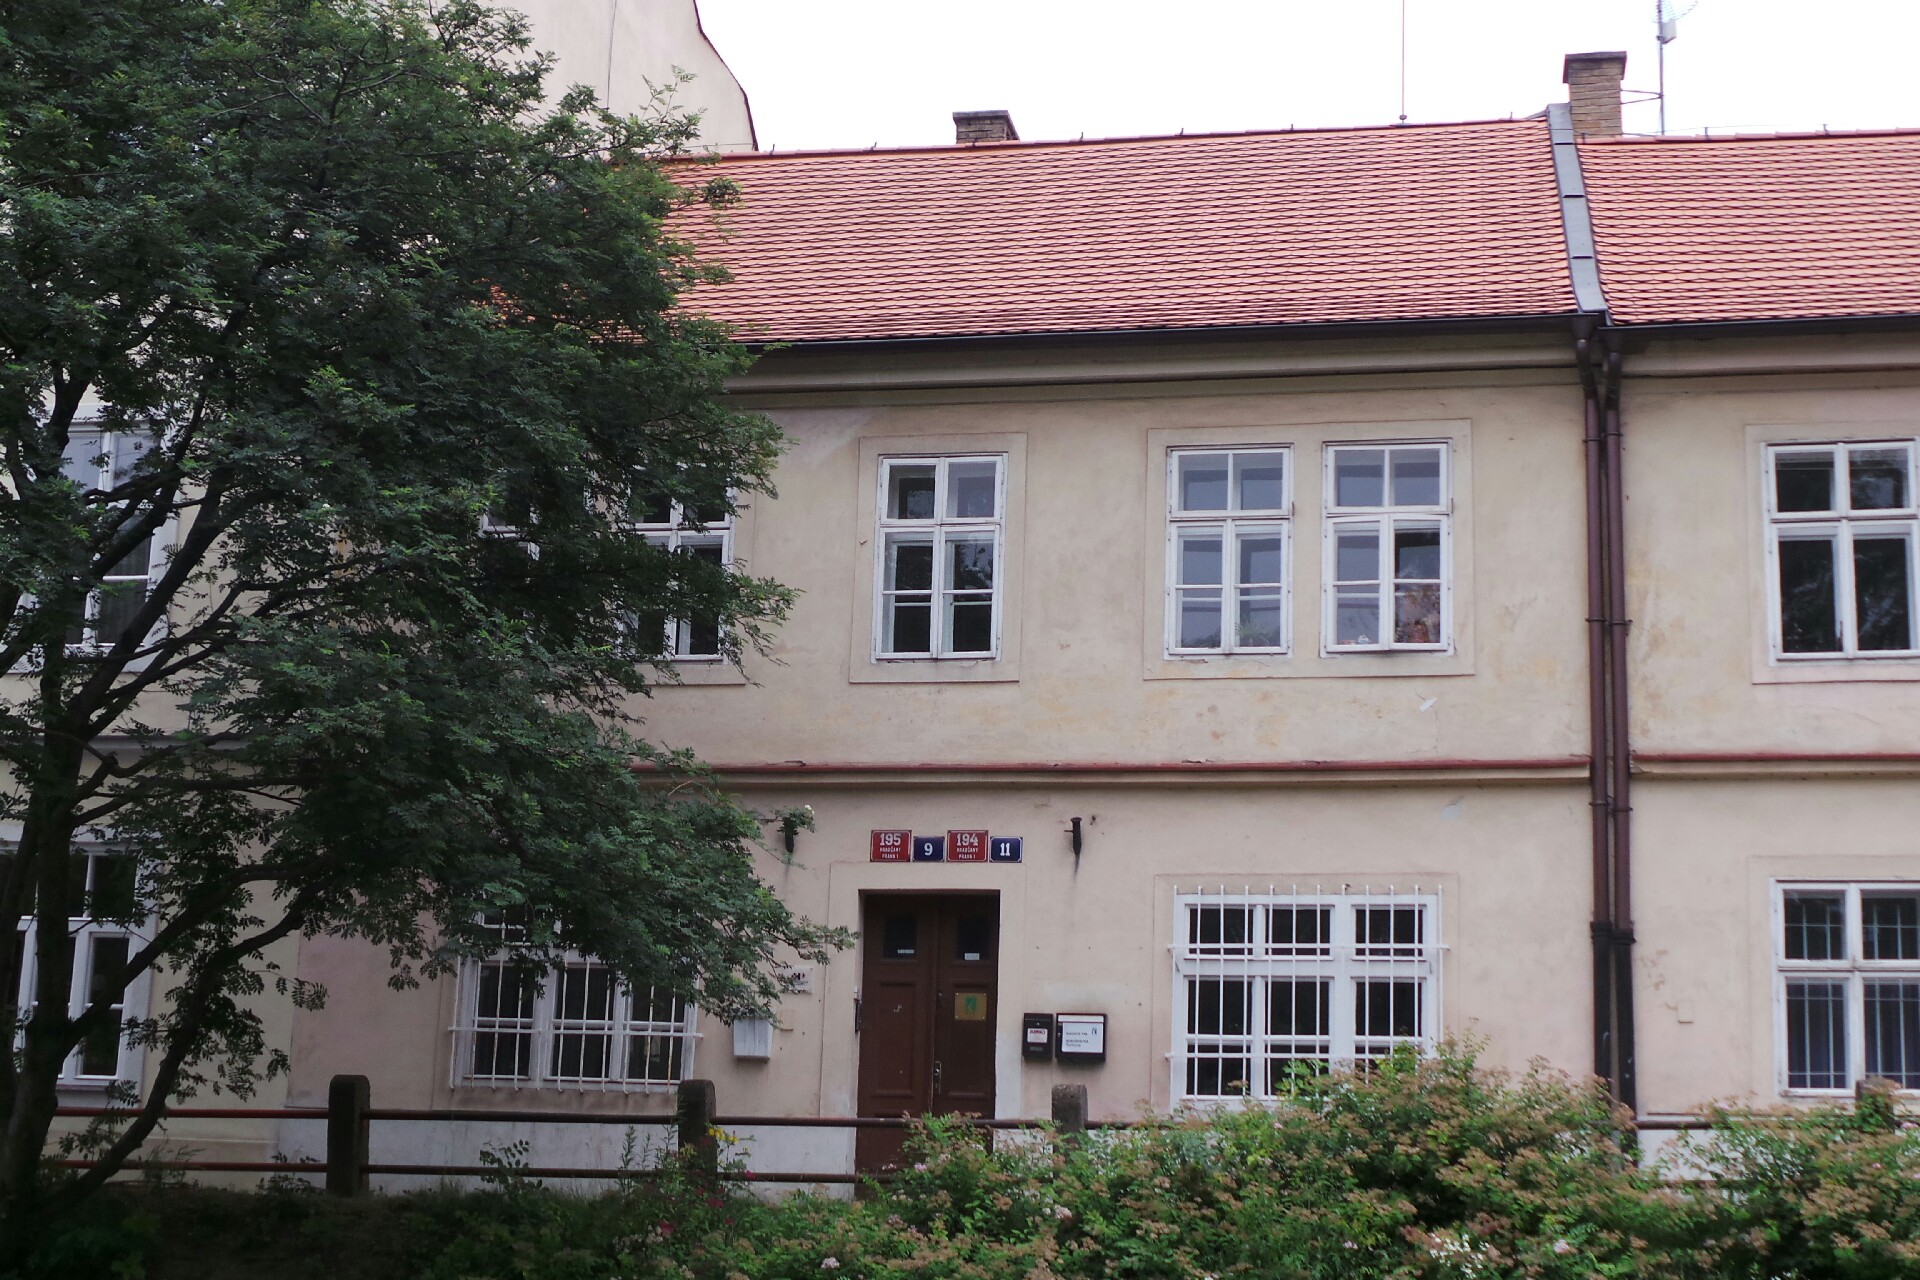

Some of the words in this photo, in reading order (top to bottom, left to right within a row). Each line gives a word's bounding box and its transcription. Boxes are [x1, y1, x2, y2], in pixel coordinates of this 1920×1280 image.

[880, 832, 901, 846] 195
[956, 833, 978, 846] 194
[924, 842, 933, 856] 9
[1000, 842, 1011, 856] 11
